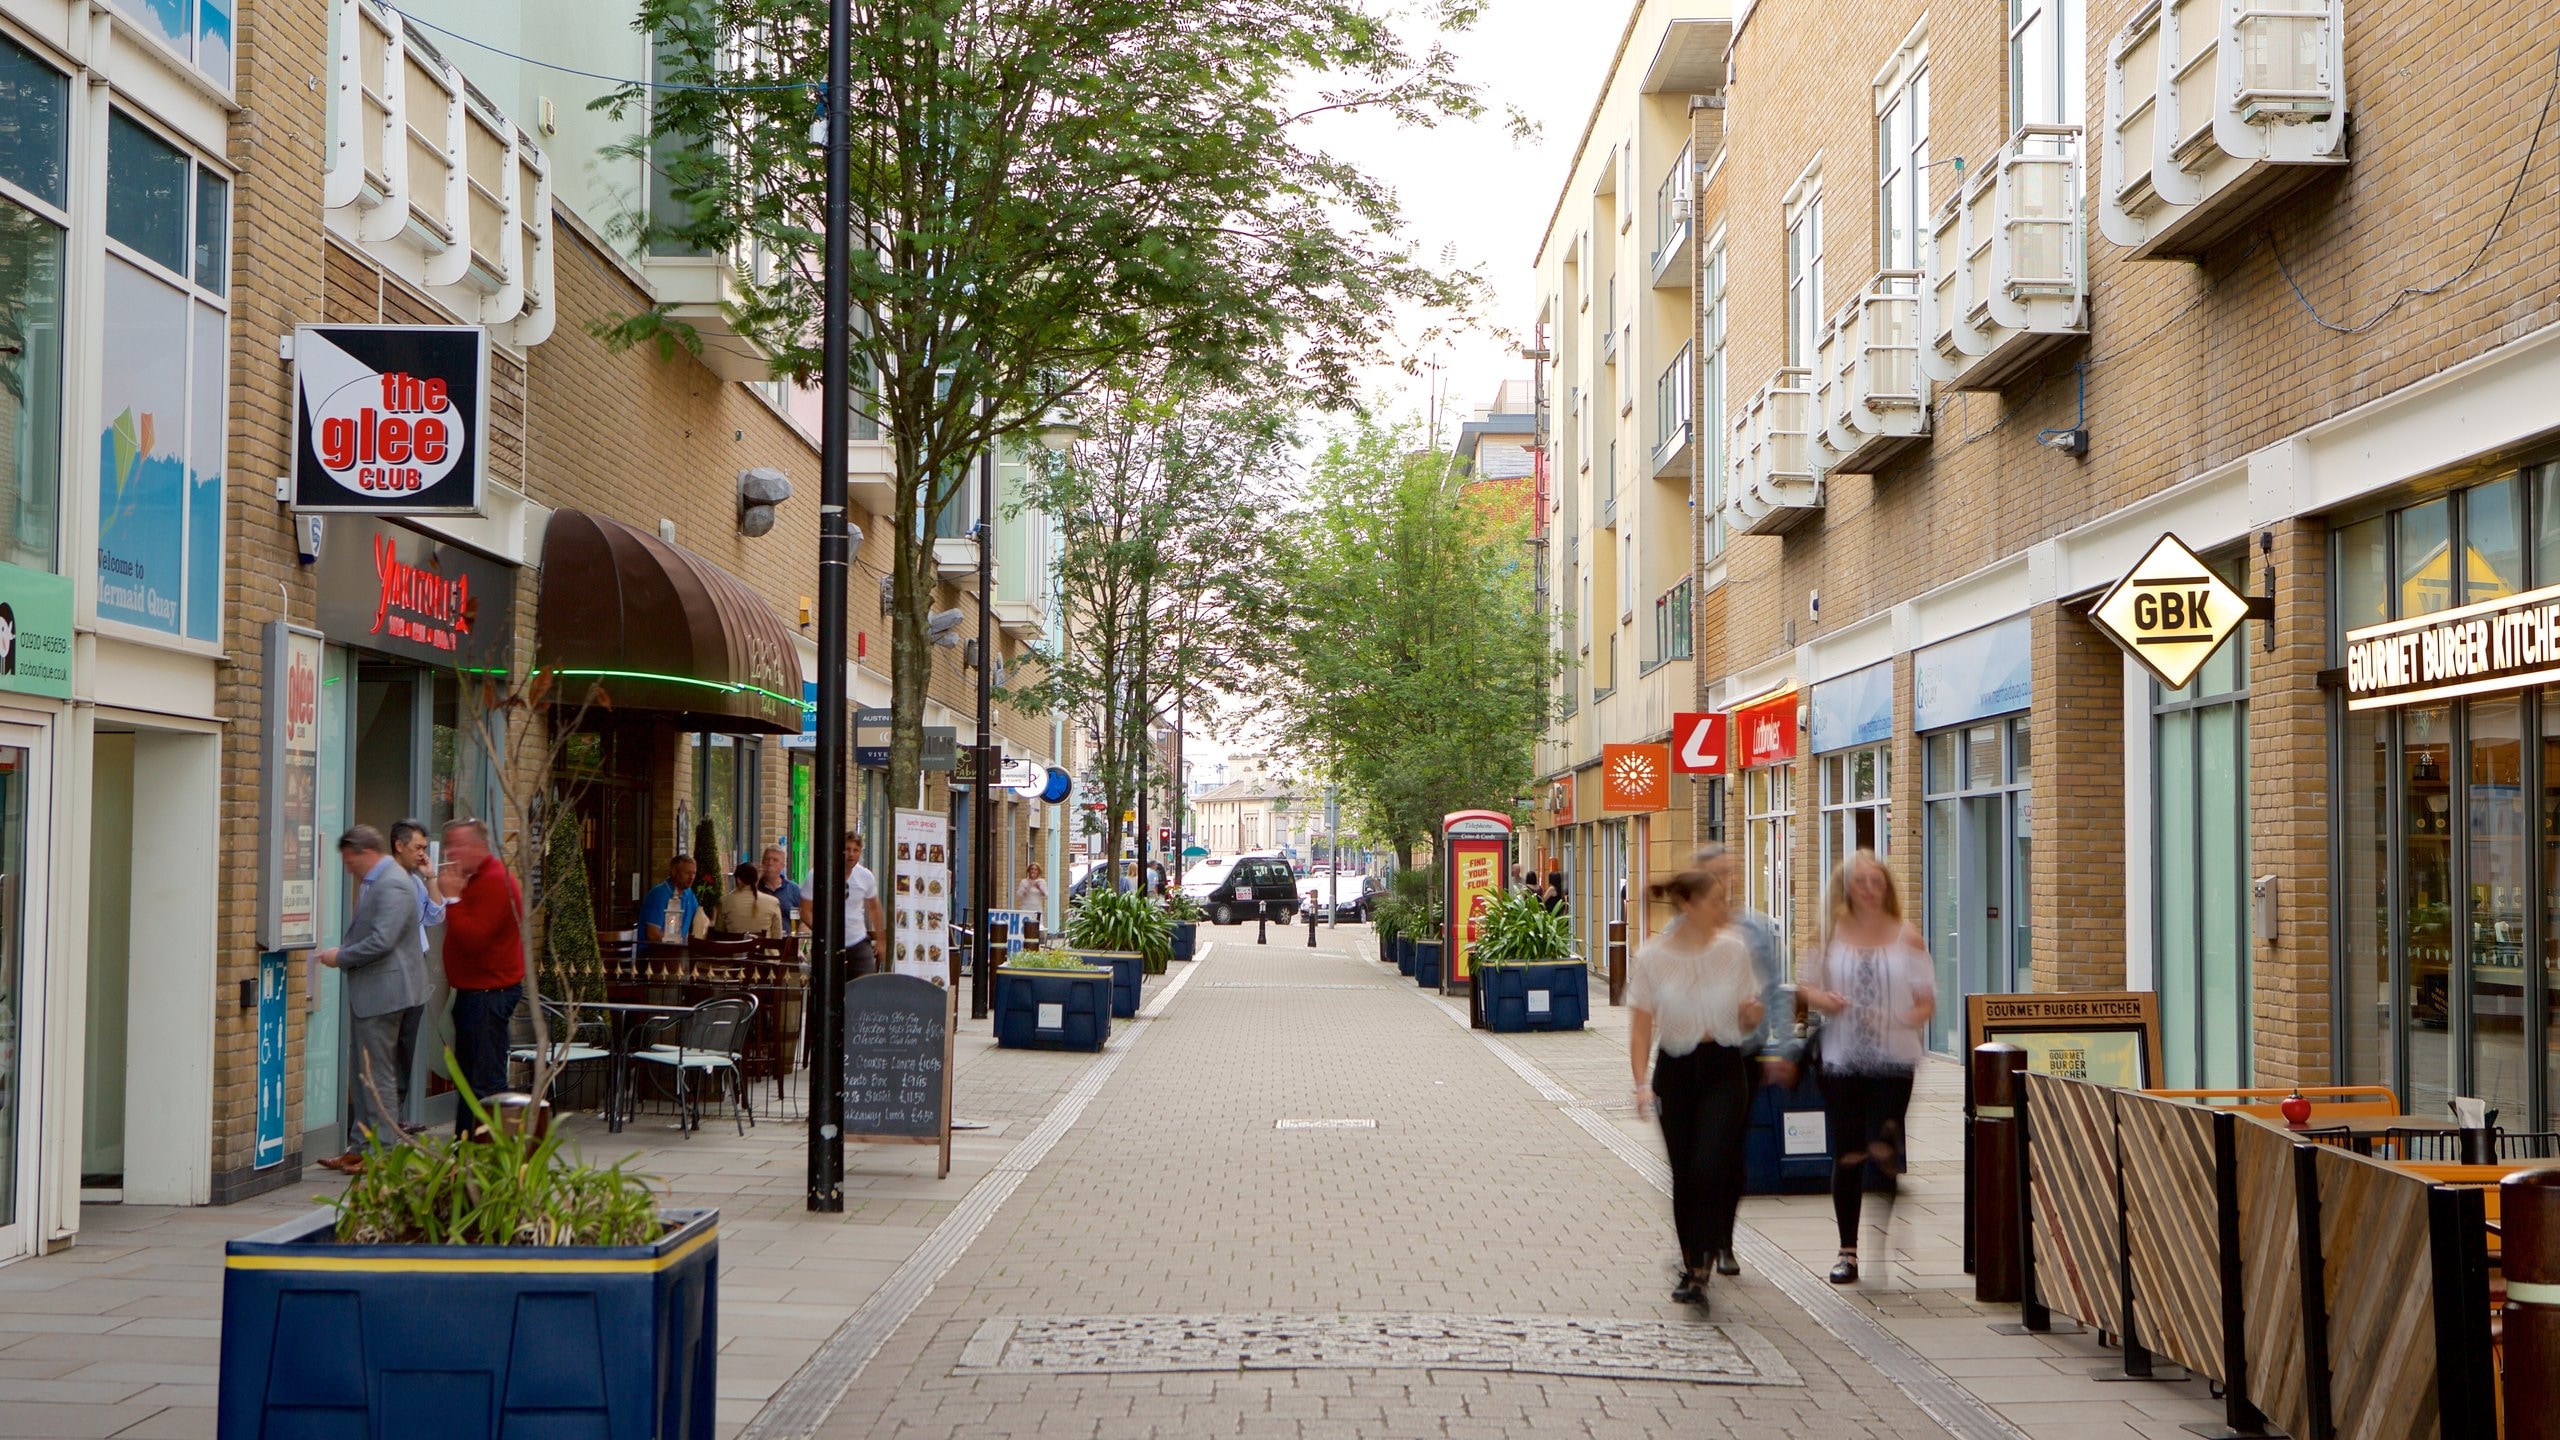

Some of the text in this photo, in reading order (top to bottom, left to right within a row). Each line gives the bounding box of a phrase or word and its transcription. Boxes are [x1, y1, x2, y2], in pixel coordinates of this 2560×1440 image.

[381, 371, 450, 413] the
[322, 407, 450, 472] glee
[358, 467, 423, 491] CLUB
[136, 560, 144, 579] to
[147, 588, 177, 627] Quay
[2134, 590, 2212, 631] GBK
[20, 631, 41, 651] 02920
[2347, 604, 2560, 693] GOURMET BURGER KITCHE
[287, 652, 314, 741] glee
[1469, 858, 1487, 867] FIND
[1468, 868, 1488, 878] YOUR
[1467, 879, 1489, 890] FLOW
[1986, 1001, 2141, 1017] GOURMET BURGER KITCHEN
[2049, 1051, 2084, 1060] GOURMET
[2050, 1060, 2086, 1070] BURGER
[844, 1108, 881, 1127] akeaway
